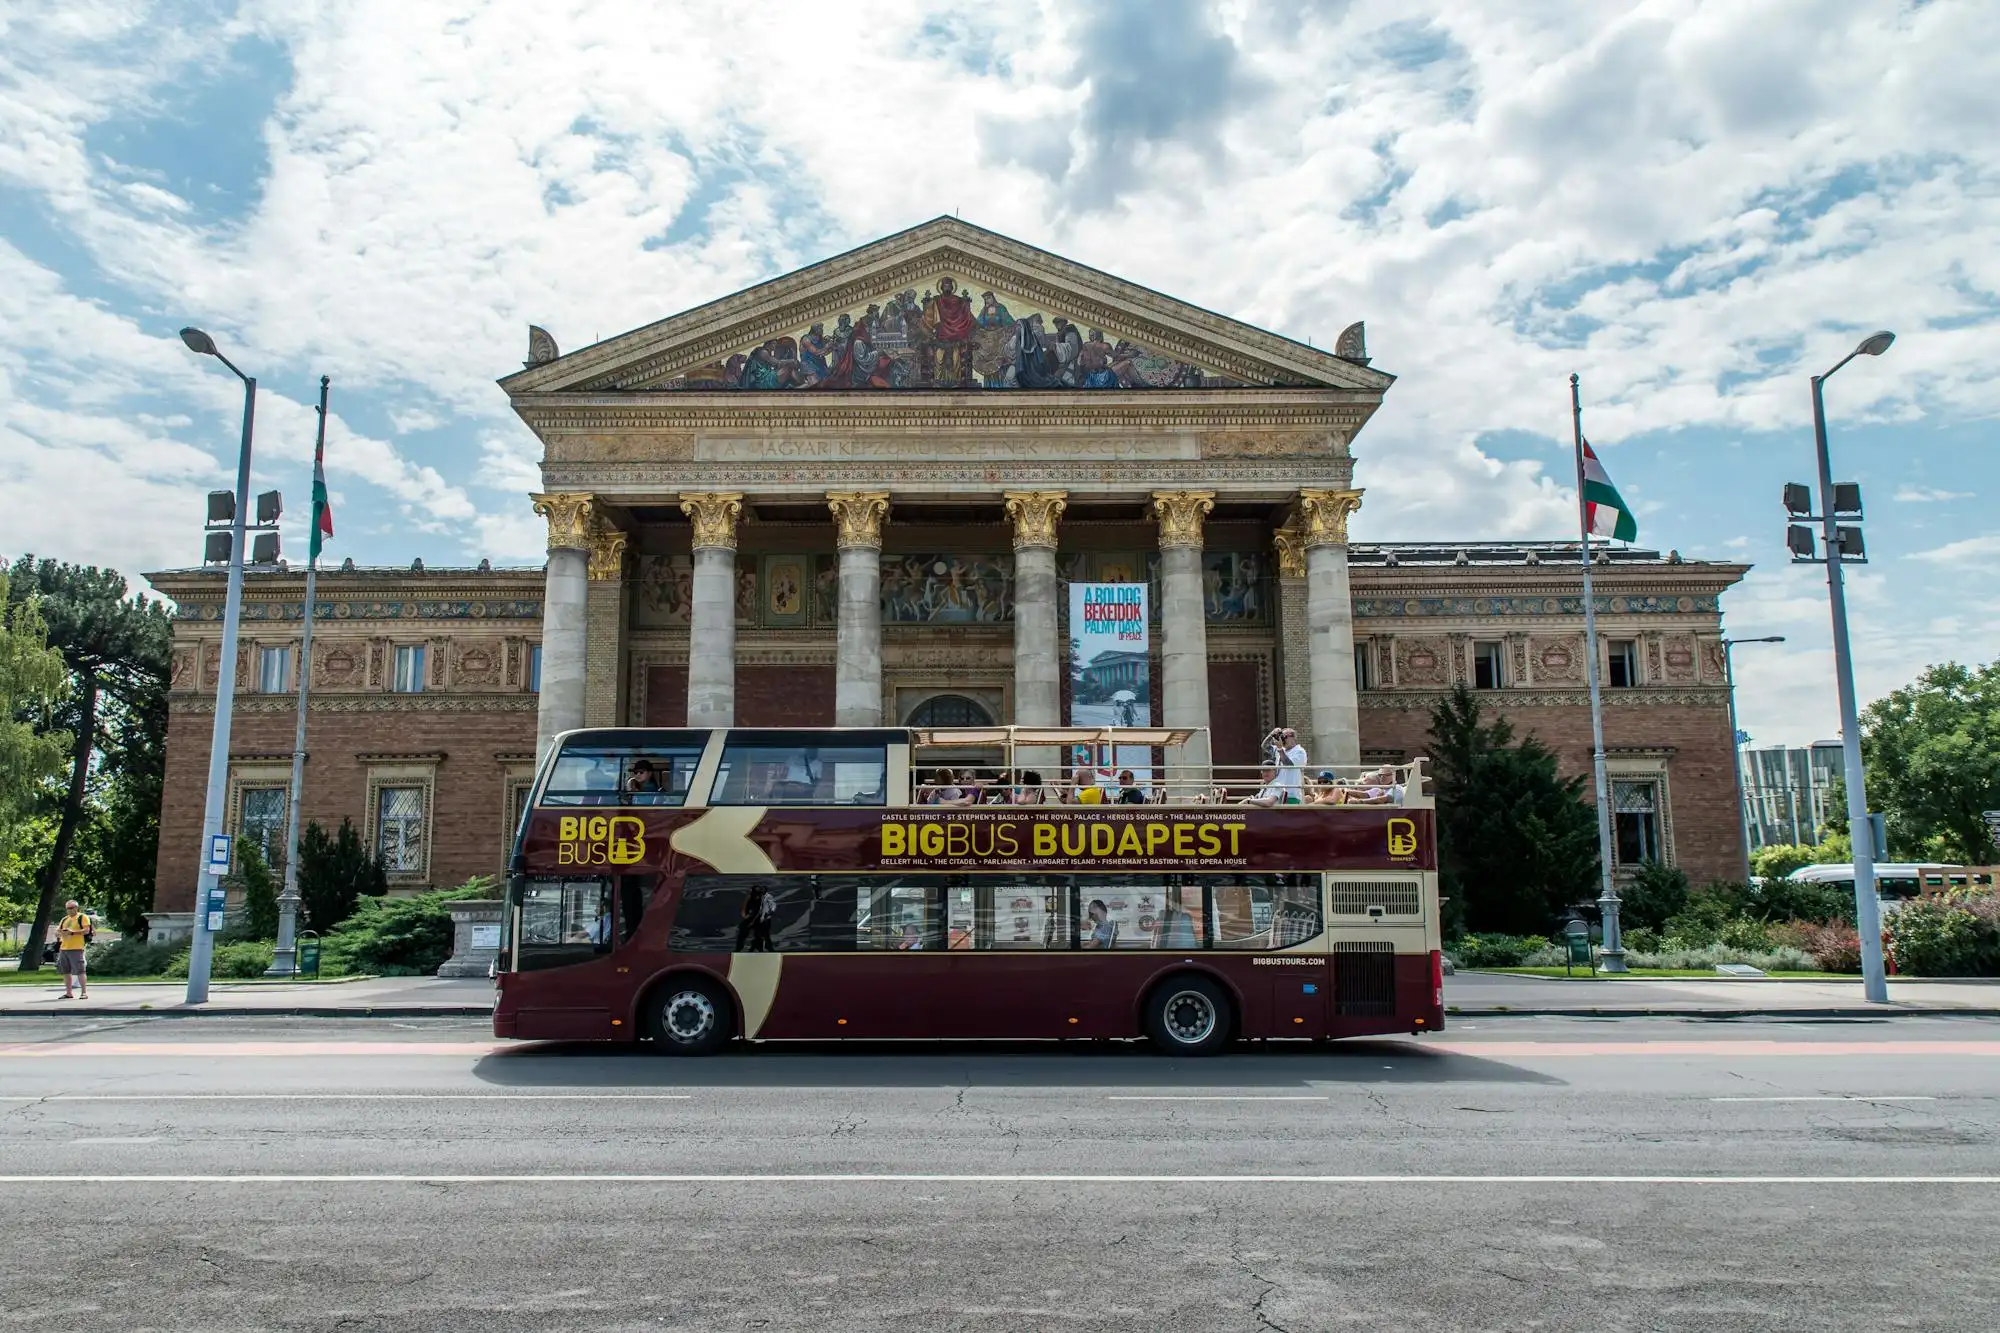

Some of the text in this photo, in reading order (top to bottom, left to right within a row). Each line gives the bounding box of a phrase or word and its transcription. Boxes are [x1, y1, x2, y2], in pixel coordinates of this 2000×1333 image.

[1085, 587, 1092, 603] A
[1085, 619, 1142, 634] PALMY DAYS
[560, 816, 608, 841] BIG
[1033, 823, 1246, 856] BUDAPEST
[558, 842, 606, 865] BUS
[1252, 957, 1325, 966] BIGBUSTOURS.COM
